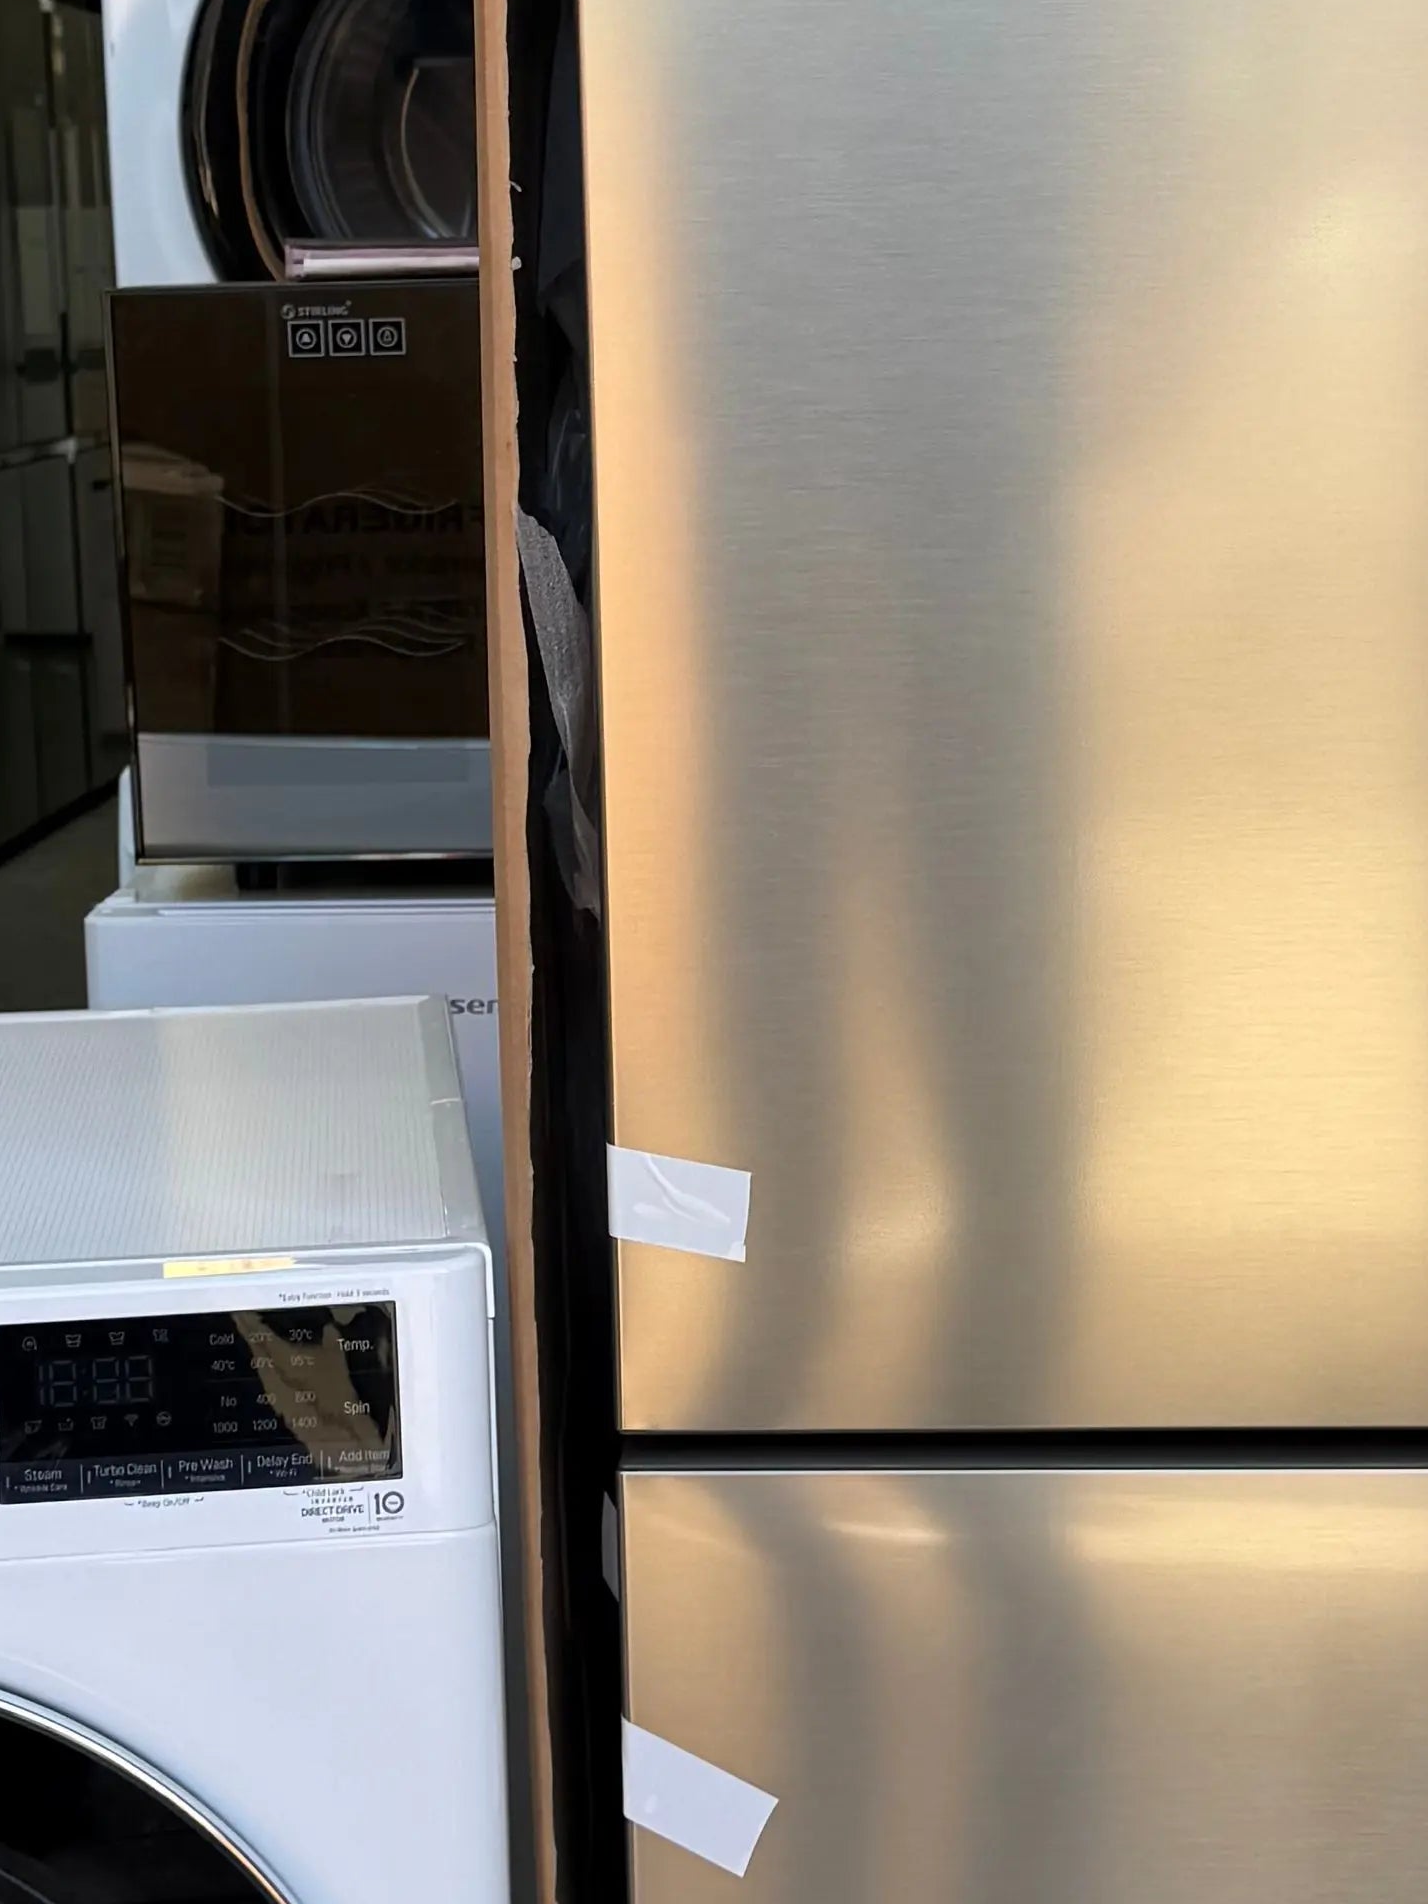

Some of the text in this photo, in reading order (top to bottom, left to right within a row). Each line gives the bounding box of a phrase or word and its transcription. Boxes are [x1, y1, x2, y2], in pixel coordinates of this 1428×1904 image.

[209, 1333, 234, 1346] Cold
[337, 1338, 374, 1353] Temp.
[343, 1401, 370, 1416] Spin
[252, 1418, 278, 1431] 1200
[257, 1453, 312, 1468] Delay End
[339, 1449, 390, 1463] Add Item
[94, 1462, 157, 1477] Turbo Clean
[179, 1458, 233, 1473] Pre Wash
[24, 1468, 62, 1482] Steam
[301, 1504, 364, 1517] DIRECT DRIVE
